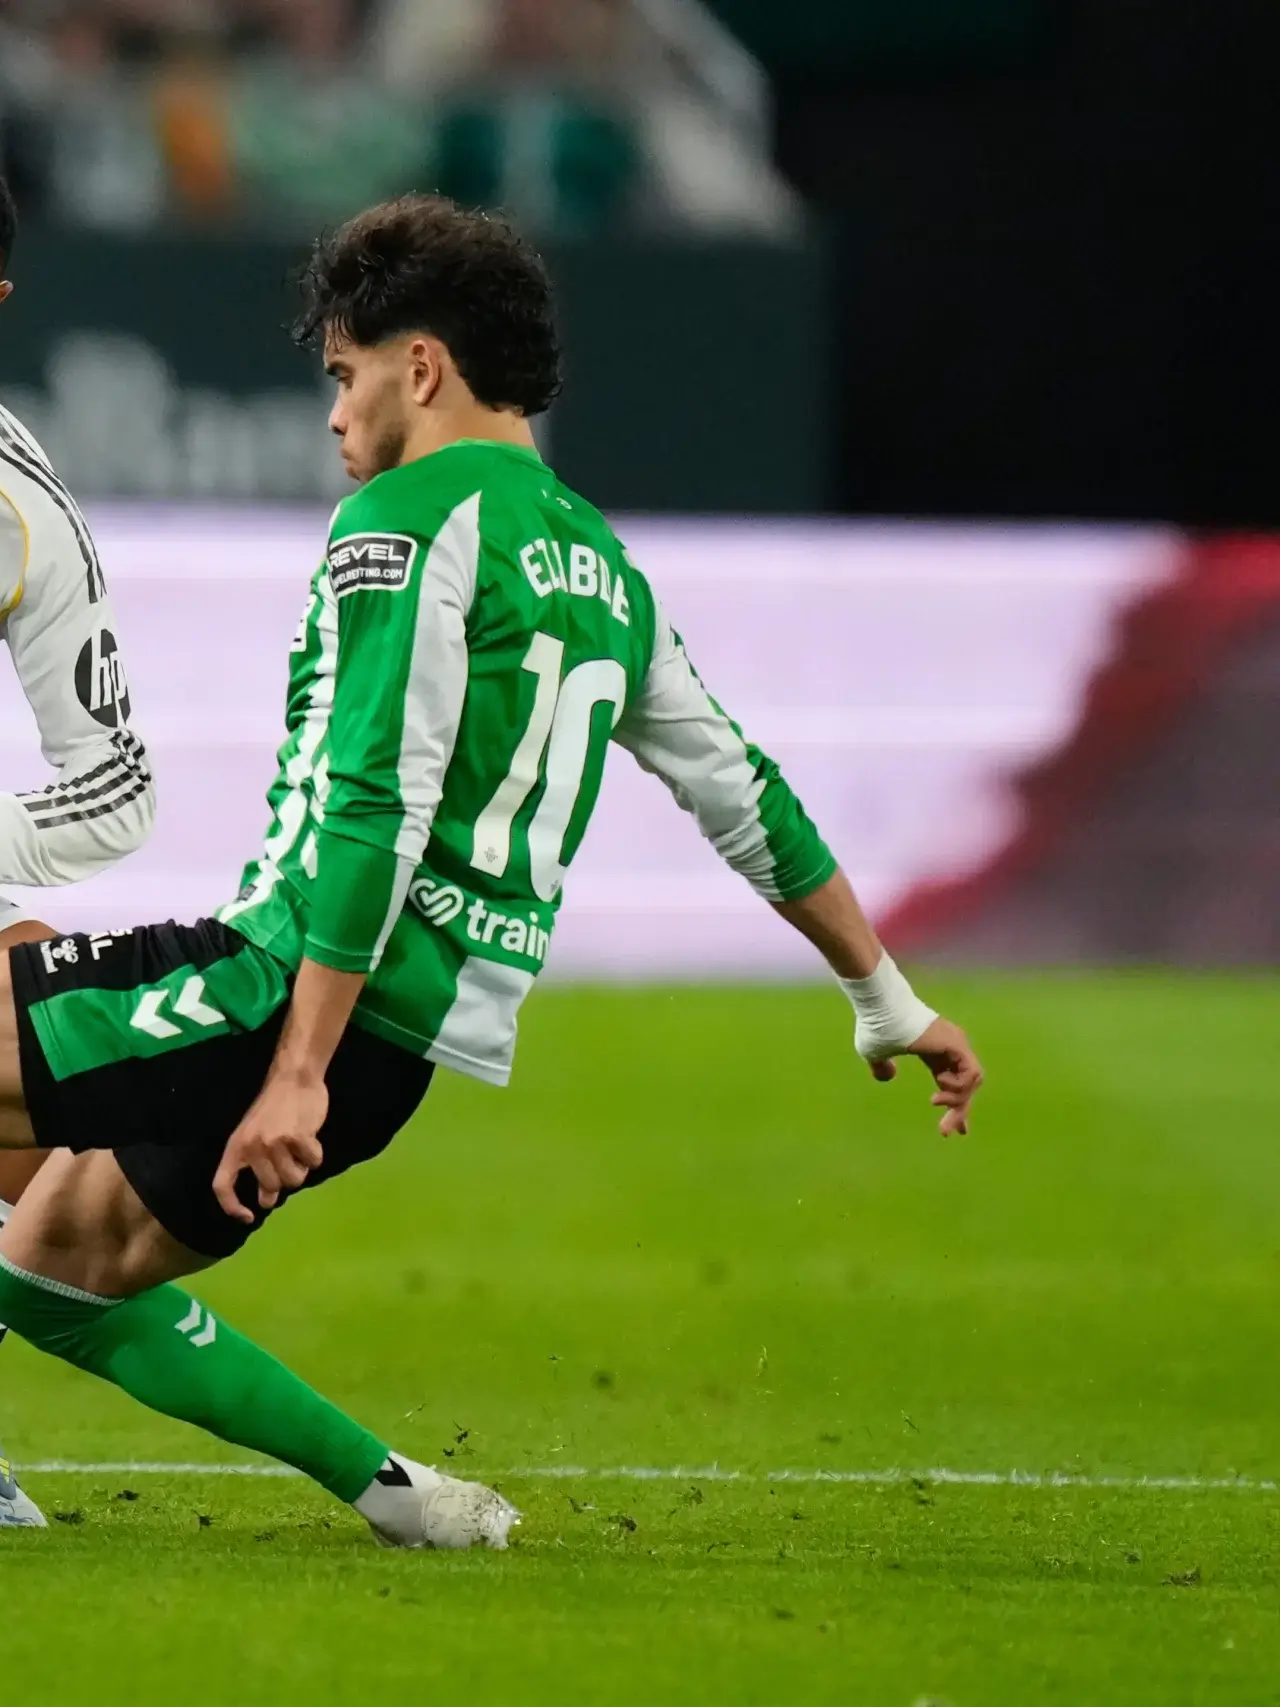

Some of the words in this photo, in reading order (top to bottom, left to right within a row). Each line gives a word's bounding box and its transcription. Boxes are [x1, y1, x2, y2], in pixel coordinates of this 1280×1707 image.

[329, 543, 406, 568] REVEL
[86, 628, 130, 729] hp
[470, 631, 627, 903] 10
